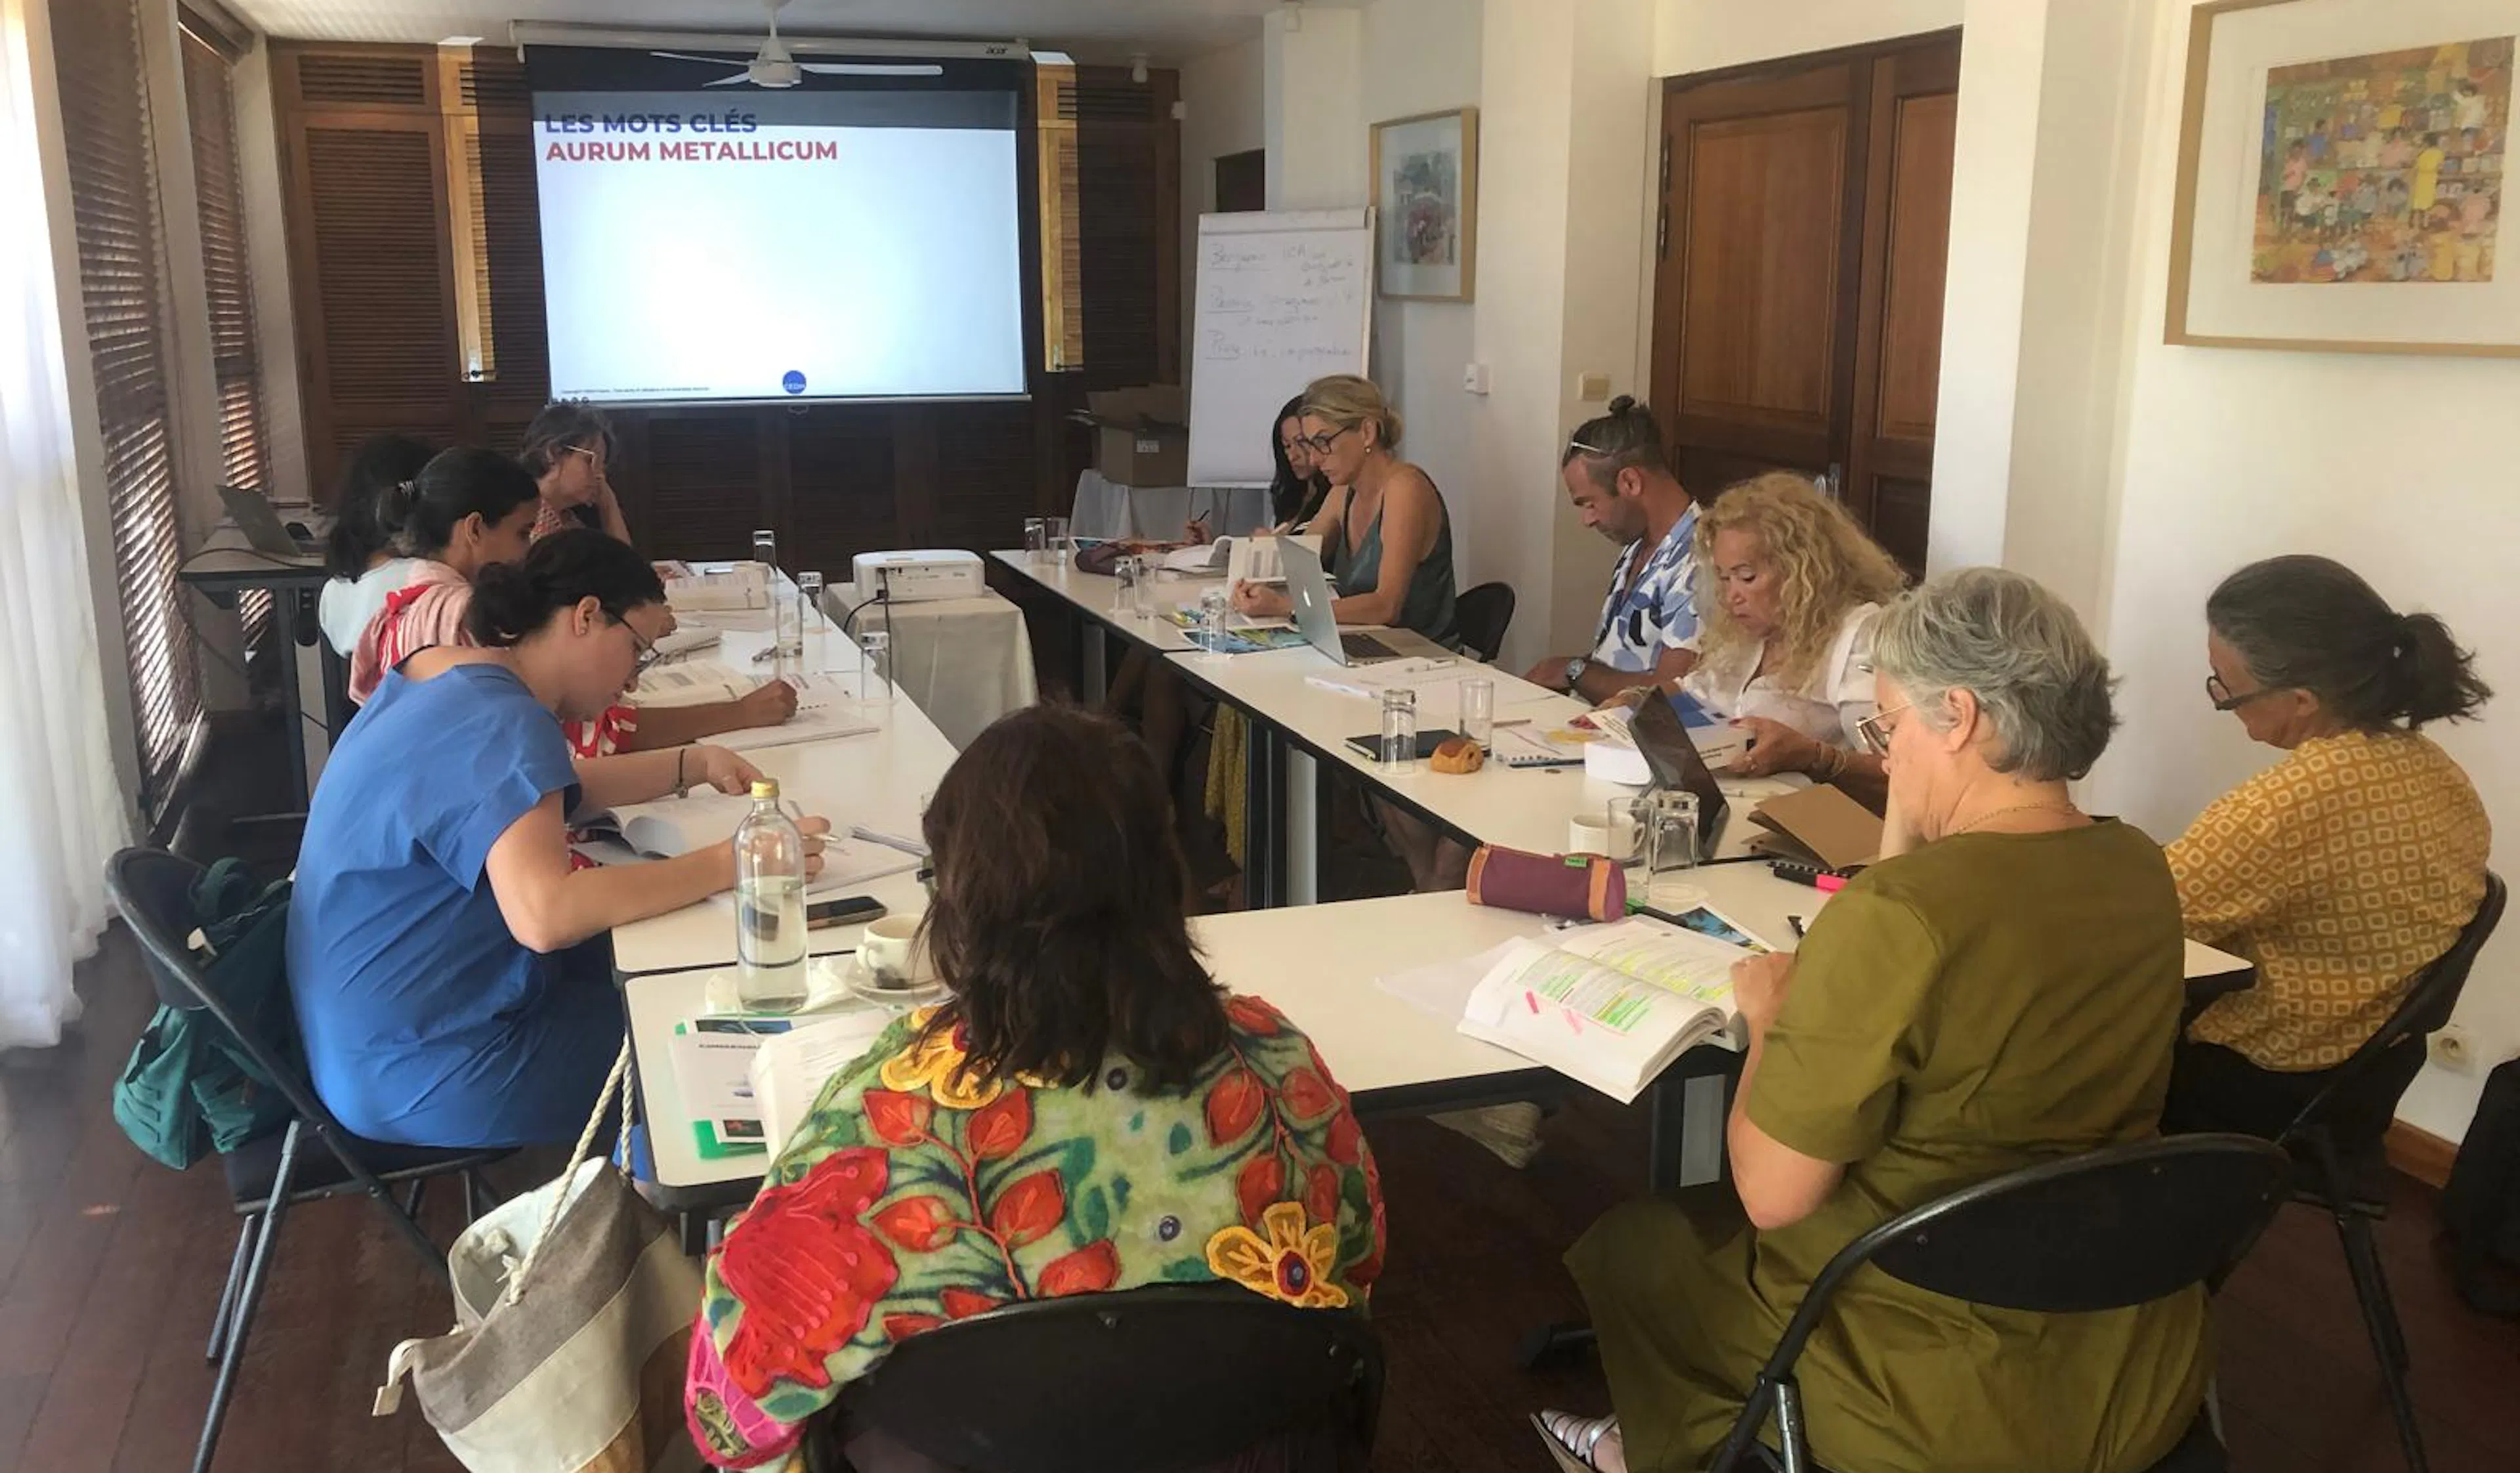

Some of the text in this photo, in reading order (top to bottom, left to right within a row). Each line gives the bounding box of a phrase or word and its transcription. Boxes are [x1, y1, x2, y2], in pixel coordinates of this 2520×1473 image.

[546, 109, 757, 133] LES MOTS CLÉS
[546, 141, 837, 161] AURUM METALLICUM
